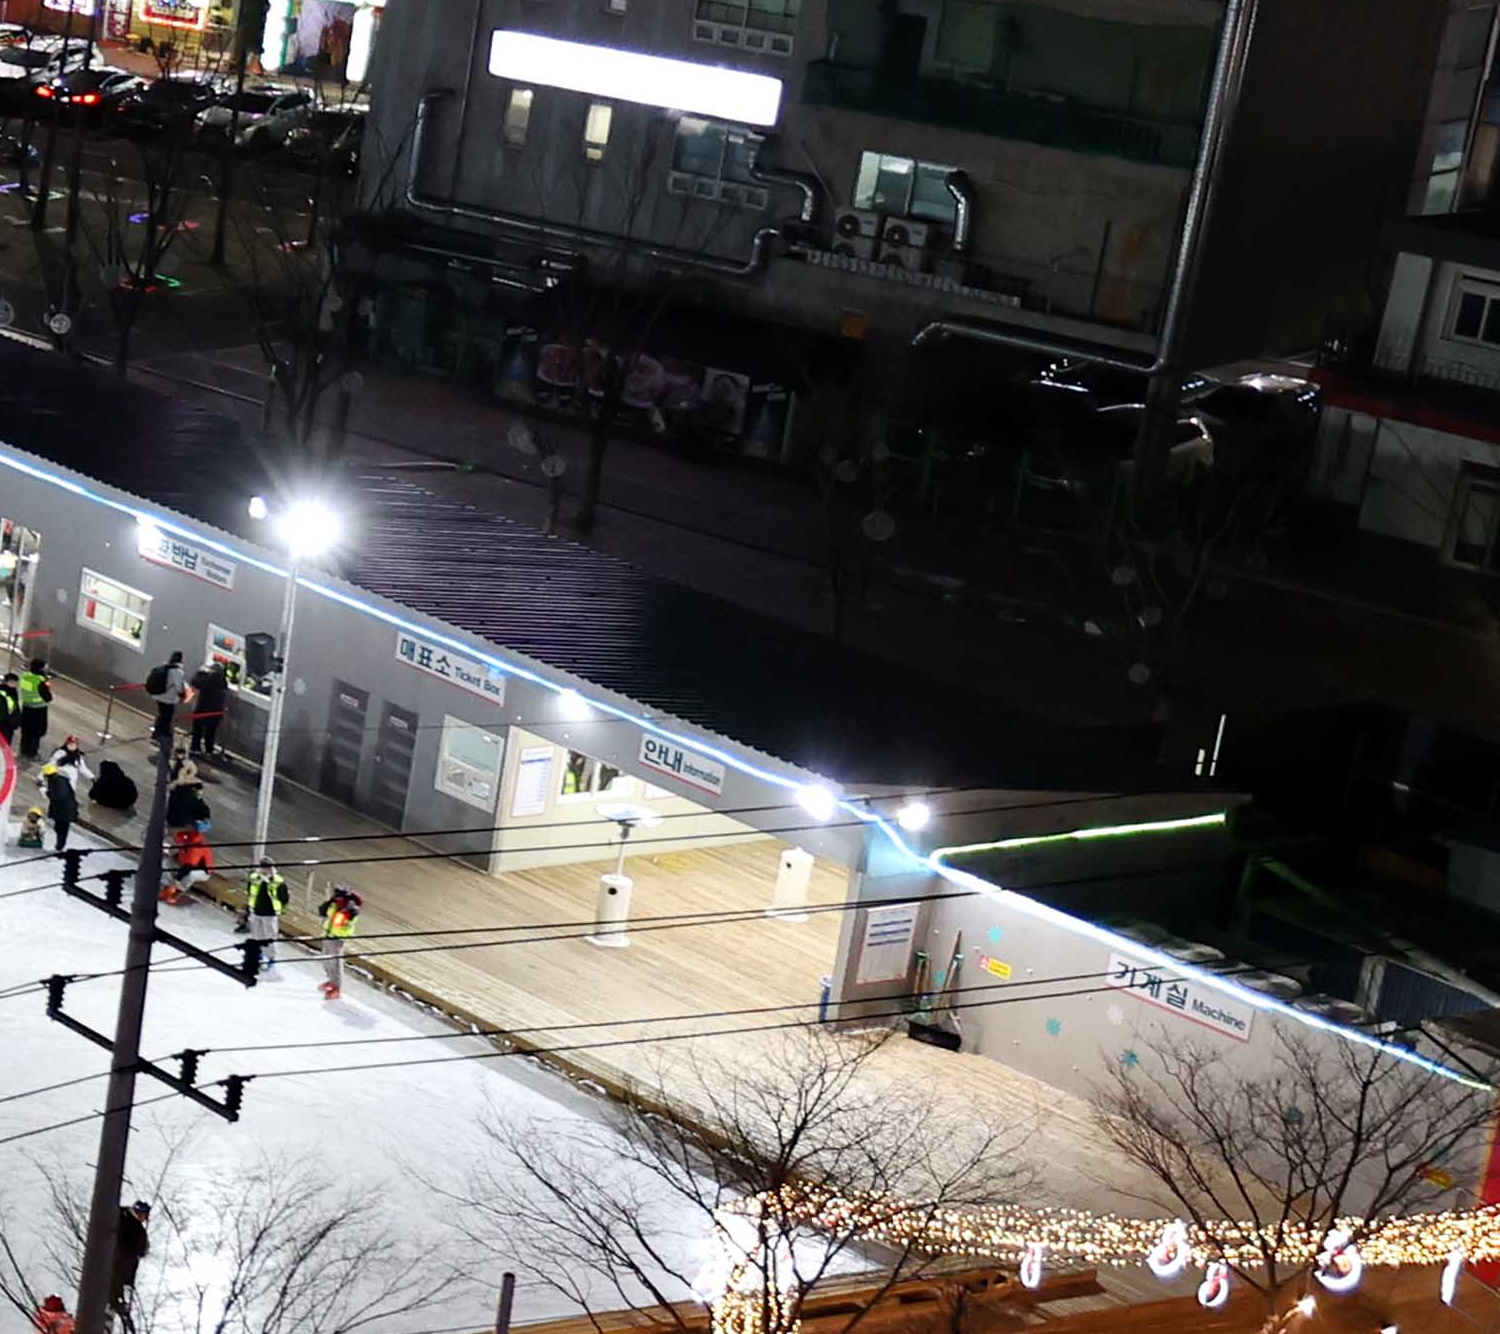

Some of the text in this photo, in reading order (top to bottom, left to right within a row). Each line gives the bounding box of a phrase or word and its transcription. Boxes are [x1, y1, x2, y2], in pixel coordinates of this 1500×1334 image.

[171, 542, 198, 571] 반납
[400, 638, 451, 677] 매표소
[644, 739, 683, 774] 안내
[1114, 961, 1247, 1032] 기계실 Machine
